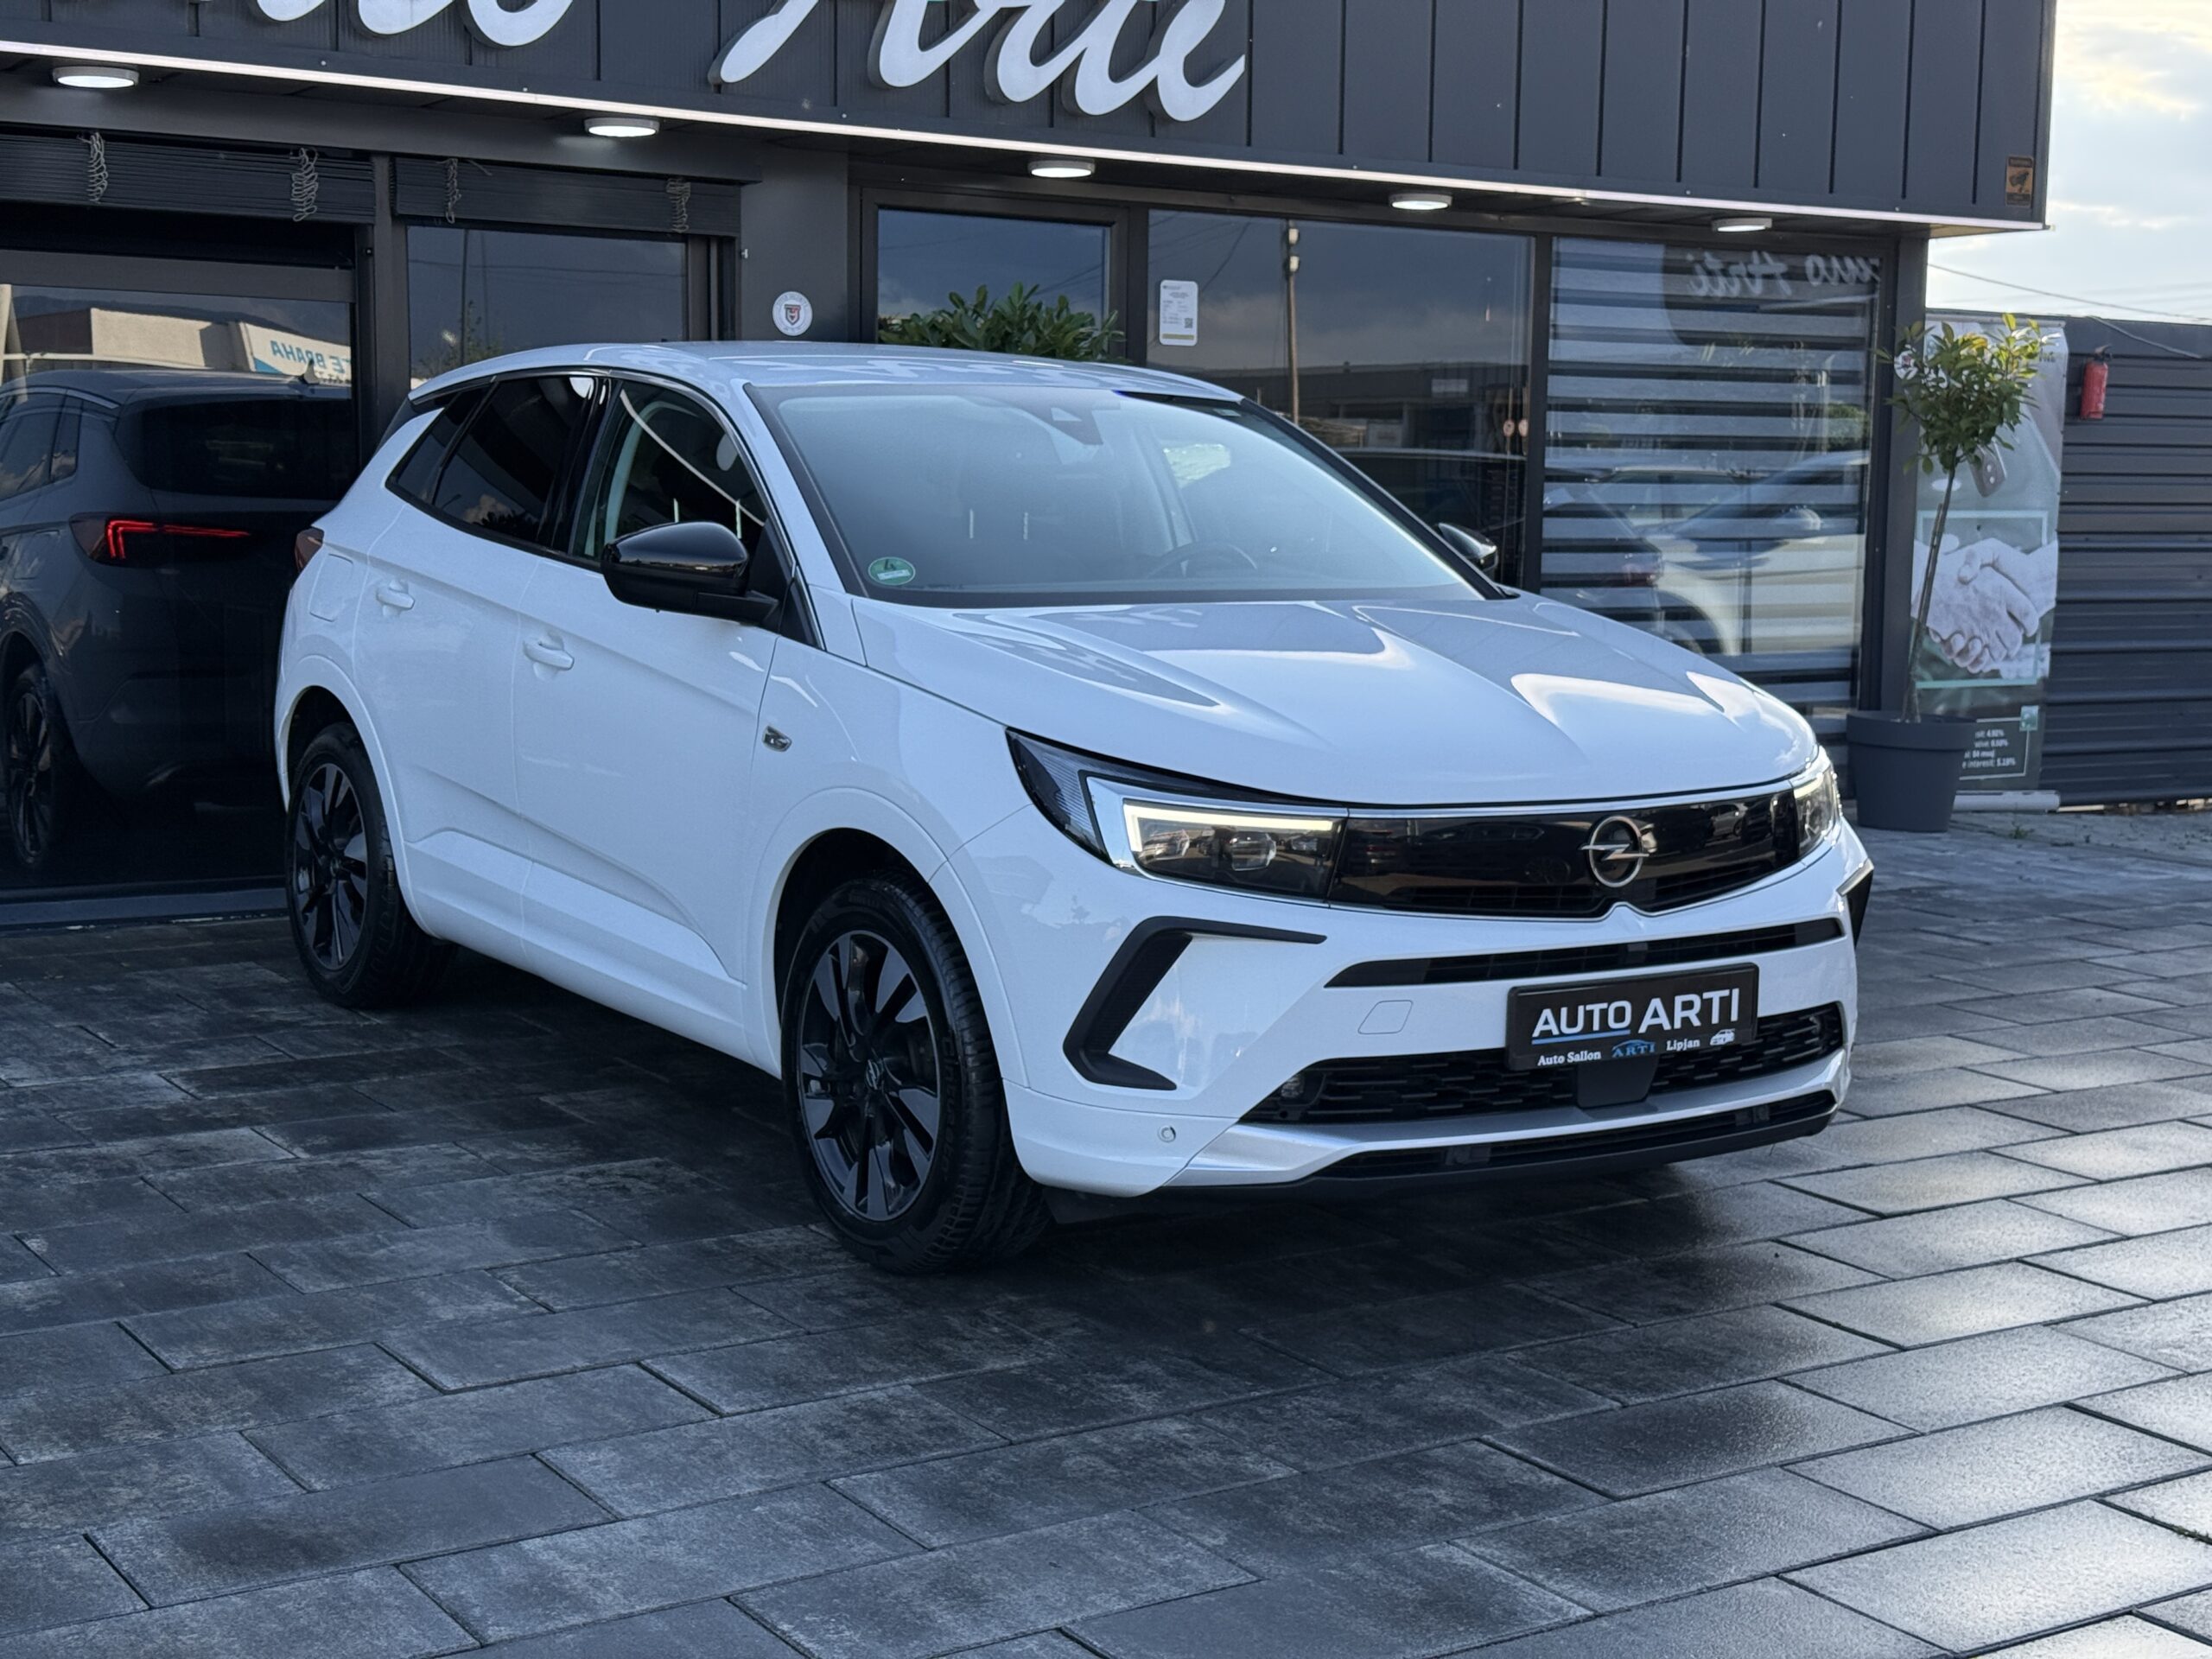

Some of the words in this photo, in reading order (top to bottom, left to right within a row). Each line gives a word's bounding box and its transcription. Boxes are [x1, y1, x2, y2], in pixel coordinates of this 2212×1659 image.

[1531, 999, 1633, 1038] AUTO
[1637, 987, 1741, 1034] ARTI
[1536, 1053, 1565, 1067] Auto
[1611, 1042, 1656, 1058] ARTI
[1665, 1037, 1701, 1052] Lipjan
